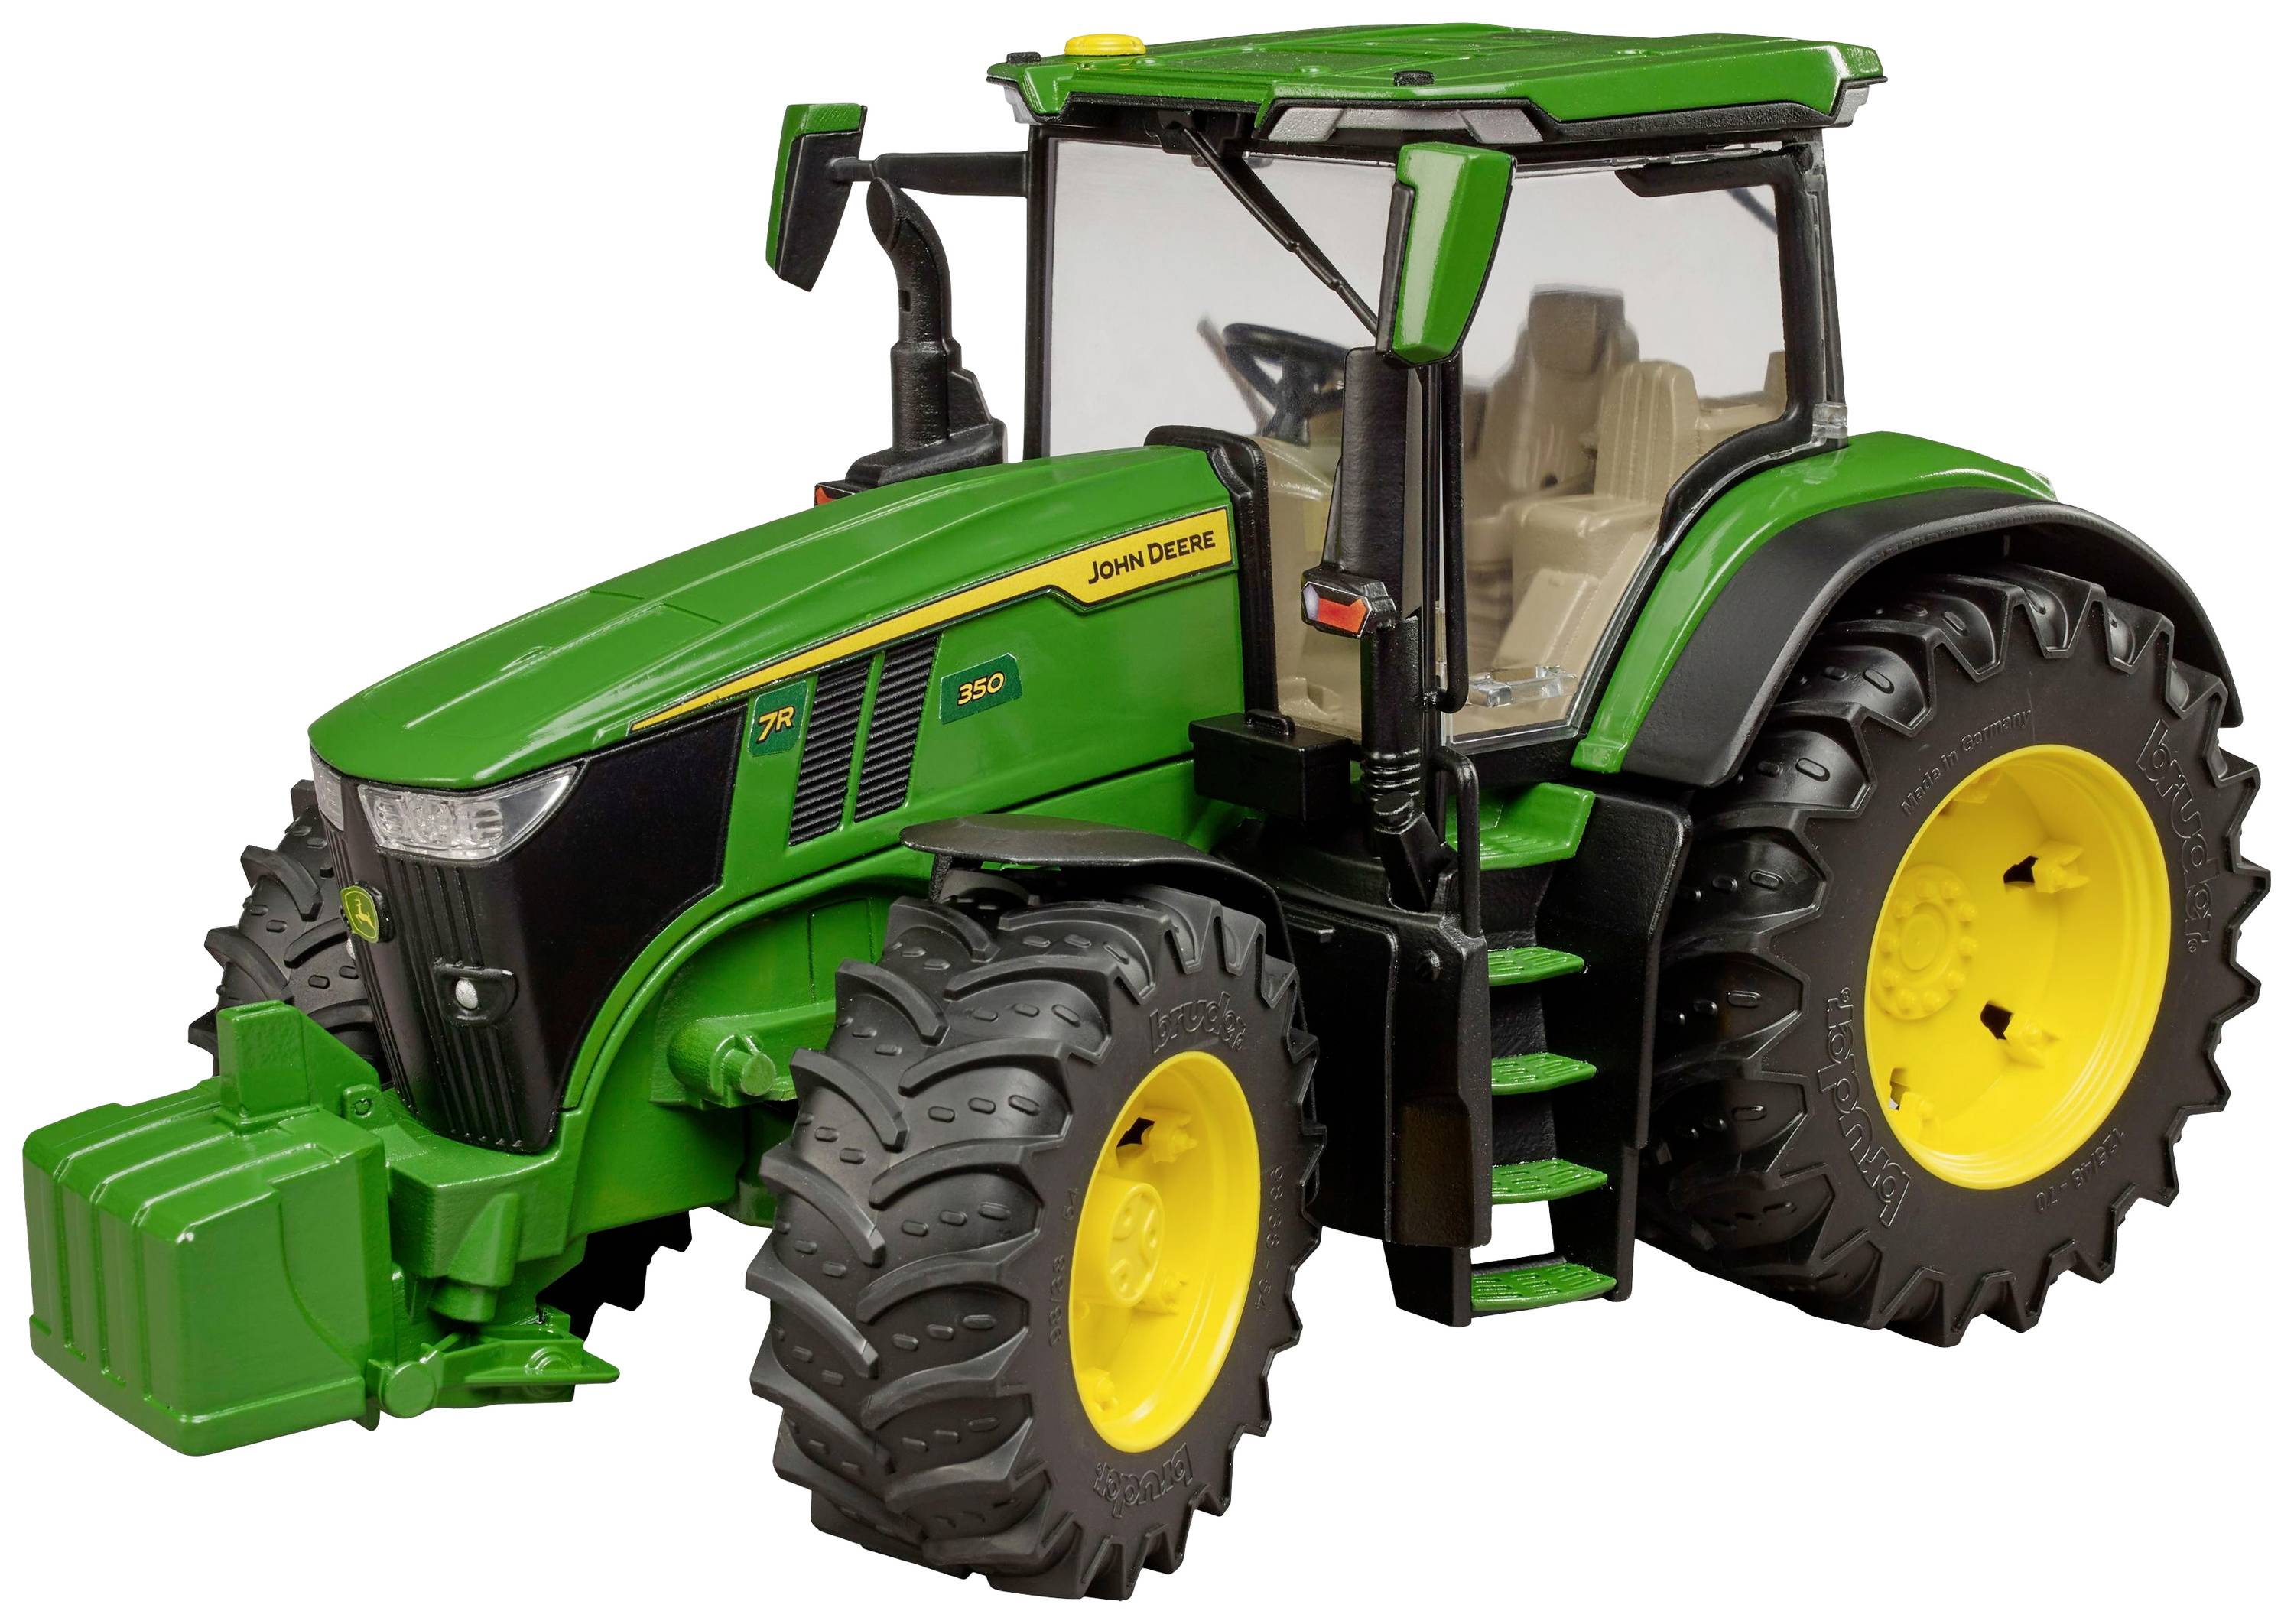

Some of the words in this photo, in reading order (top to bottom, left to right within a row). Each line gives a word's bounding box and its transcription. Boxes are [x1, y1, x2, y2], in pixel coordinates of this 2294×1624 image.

[1088, 551, 1145, 584] JOHN
[1147, 530, 1216, 565] DEERE
[956, 672, 1006, 706] 350
[755, 705, 795, 745] 7R
[1901, 767, 1941, 816] Made
[1940, 749, 1960, 771] in
[1961, 710, 2032, 752] Germany
